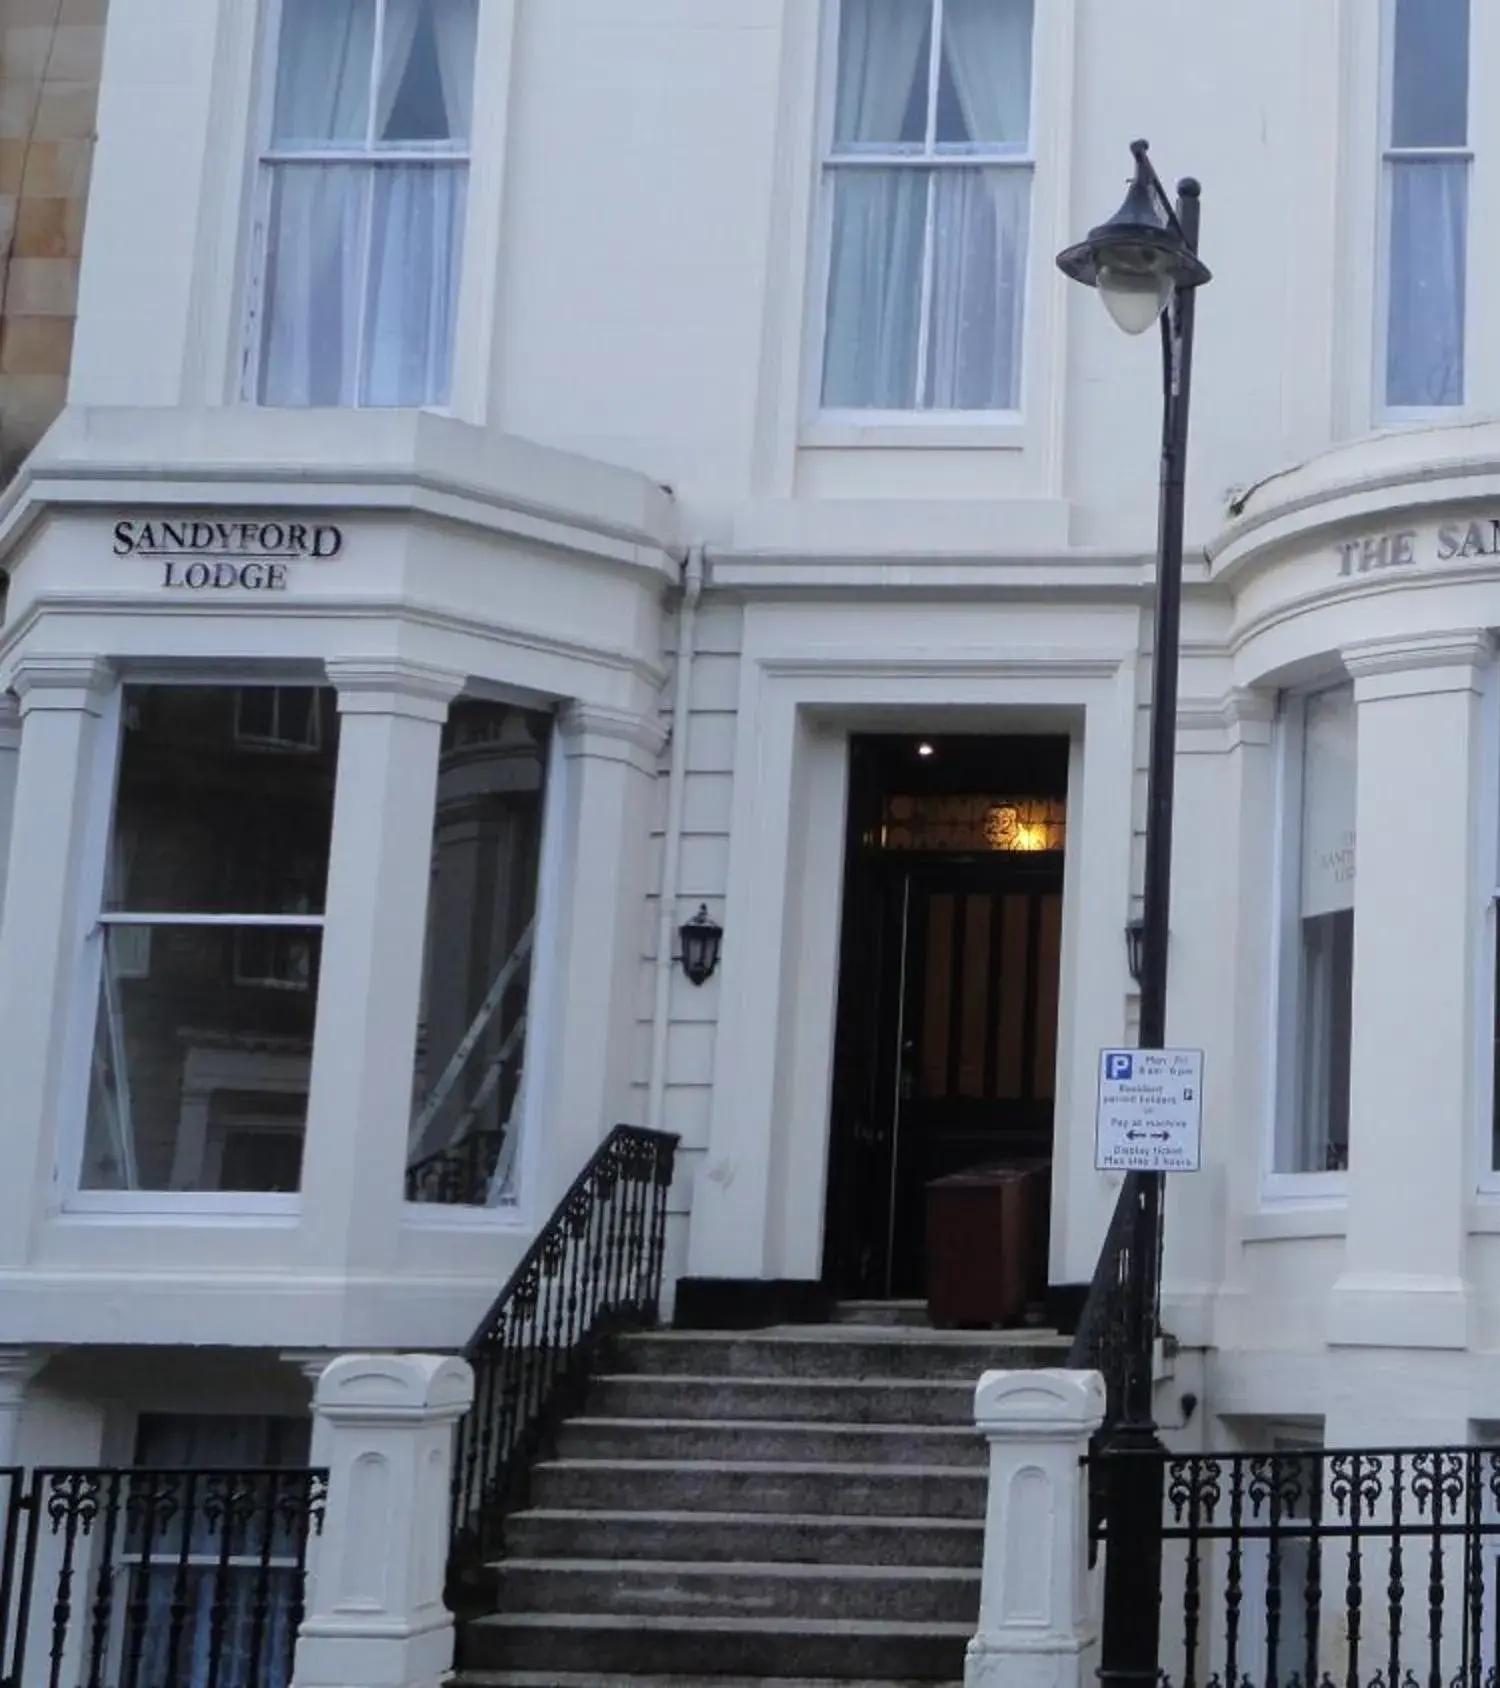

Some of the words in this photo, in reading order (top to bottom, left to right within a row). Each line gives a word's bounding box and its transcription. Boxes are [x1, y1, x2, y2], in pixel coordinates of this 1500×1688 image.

[112, 520, 343, 557] SANDYFORD
[1334, 529, 1416, 577] THE
[162, 561, 287, 590] LODGE
[1111, 1056, 1129, 1079] P
